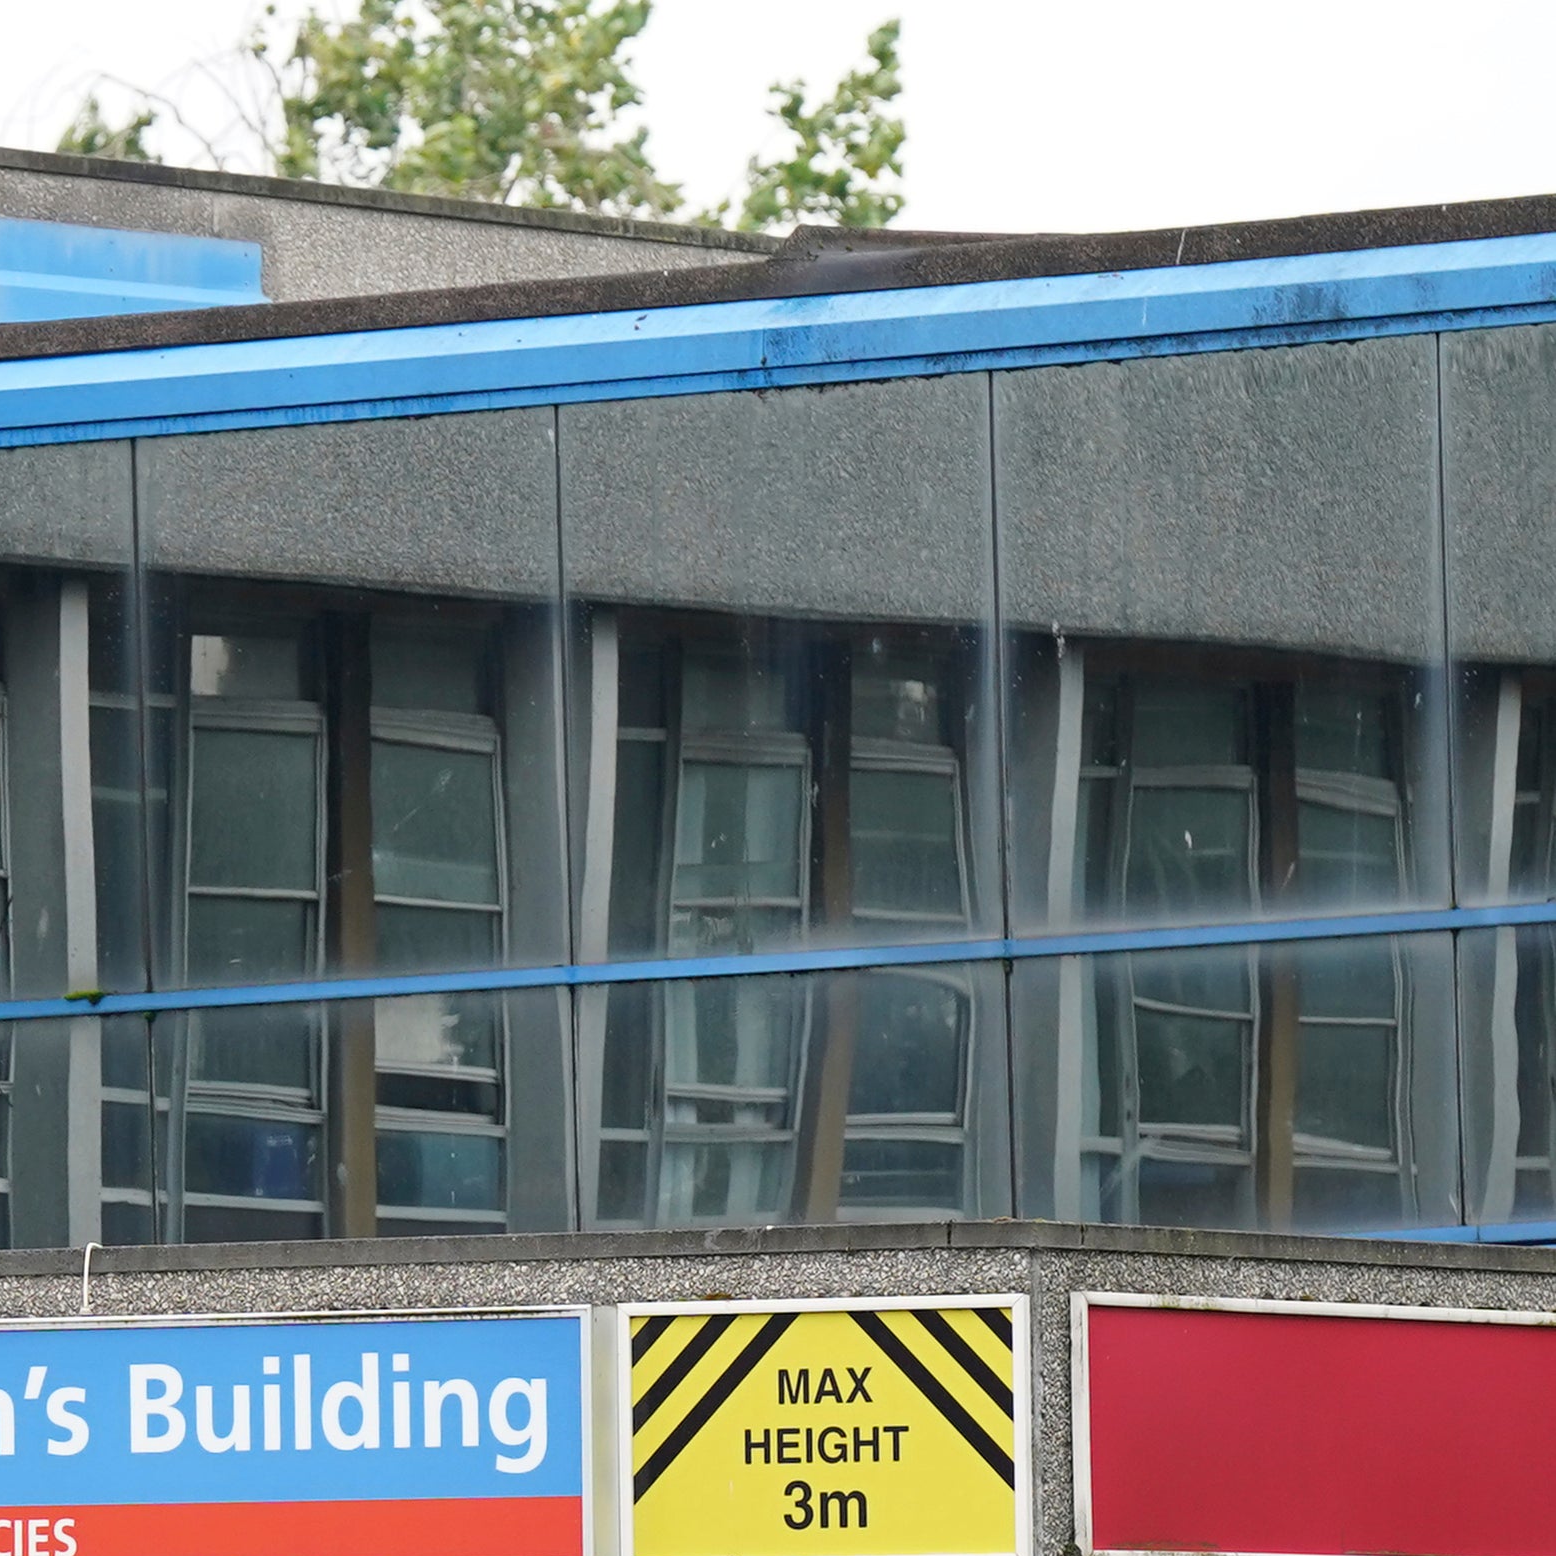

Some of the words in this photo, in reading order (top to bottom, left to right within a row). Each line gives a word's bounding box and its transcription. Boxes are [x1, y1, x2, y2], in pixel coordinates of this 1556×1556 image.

[777, 1366, 874, 1405] MAX
[129, 1354, 549, 1474] Building
[743, 1425, 910, 1465] HEIGHT
[783, 1480, 869, 1531] 3m
